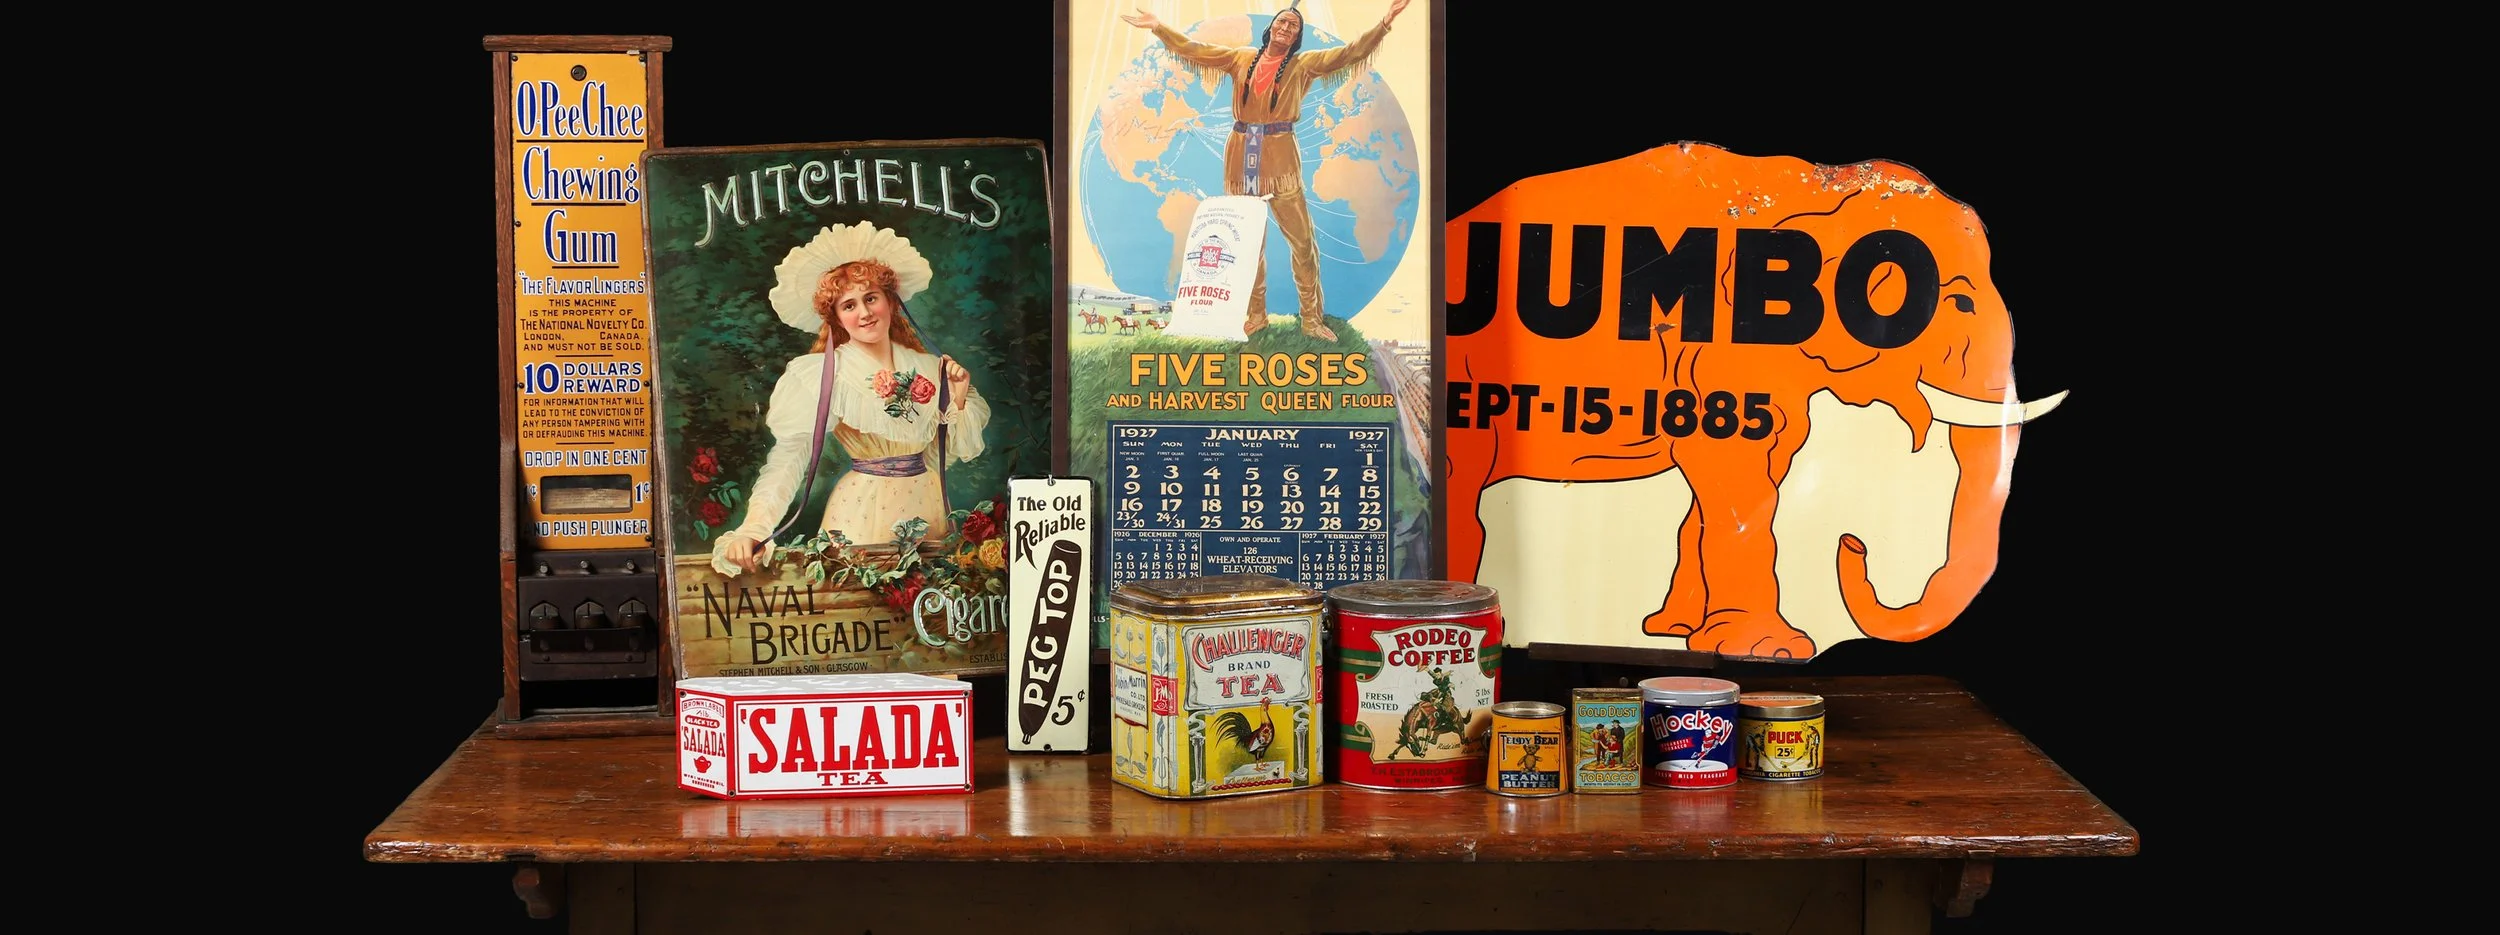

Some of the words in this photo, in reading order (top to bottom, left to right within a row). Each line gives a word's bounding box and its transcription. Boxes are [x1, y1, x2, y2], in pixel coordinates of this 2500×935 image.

[522, 146, 639, 203] Chewing
[694, 159, 1001, 248] MITCHELL'S
[544, 208, 619, 264] Gum
[545, 276, 593, 295] FLAVOR
[1446, 221, 1940, 349] JUMBO
[1178, 286, 1199, 299] FIVE
[1200, 286, 1231, 302] ROSES
[549, 299, 571, 307] THIS
[574, 299, 617, 307] MACHINE
[562, 309, 614, 317] PROPERTY
[520, 318, 537, 330] THE
[539, 319, 585, 331] NATIONAL
[586, 319, 629, 331] NOVELTY
[523, 343, 543, 351] AND
[547, 343, 574, 351] MUST
[563, 361, 643, 377] DOLLARS
[1130, 353, 1227, 387] FIVE
[1239, 353, 1368, 387] ROSES
[523, 362, 561, 395] 10
[563, 377, 641, 394] REWARD
[523, 398, 540, 406] FOR
[543, 398, 599, 406] INFORMATION
[625, 397, 644, 405] WILL
[1106, 394, 1142, 408] AND
[1148, 391, 1249, 411] HARVEST
[1260, 391, 1333, 415] QUEEN
[1341, 394, 1396, 408] FLOUR
[524, 409, 547, 417] LEAD
[549, 409, 560, 417] TO
[580, 408, 631, 416] CONVICTION
[634, 408, 645, 416] OF
[522, 419, 539, 427] ANY
[541, 419, 572, 427] PERSON
[574, 419, 620, 427] TAMPERING
[623, 418, 645, 426] WITH
[523, 430, 534, 438] OR
[536, 429, 585, 438] DEFRAUDING
[587, 429, 606, 437] THIS
[1120, 428, 1158, 438] 1927
[1205, 428, 1300, 441] JANUARY
[1349, 431, 1384, 440] 1927
[524, 451, 563, 467] DROP
[566, 451, 579, 466] IN
[583, 450, 609, 466] ONE
[613, 450, 648, 465] CENT
[1366, 452, 1373, 465] 1
[1125, 465, 1141, 479] 2
[1163, 465, 1179, 479] 3
[1203, 466, 1221, 480] 4
[1245, 467, 1260, 481] 5
[1283, 467, 1300, 481] 6
[1323, 468, 1339, 482] 7
[1361, 468, 1378, 483] 8
[1123, 481, 1141, 495] 9
[1160, 482, 1183, 496] 10
[1204, 483, 1220, 497] 11
[1242, 484, 1263, 497] 12
[1282, 484, 1302, 498] 13
[1319, 484, 1341, 499] 14
[1359, 485, 1381, 499] 15
[1016, 496, 1047, 512] The
[1052, 495, 1082, 511] Old
[1121, 498, 1143, 512] 16
[1161, 499, 1183, 512] 17
[1202, 499, 1222, 513] 18
[1242, 500, 1264, 513] 19
[1279, 501, 1305, 514] 20
[1320, 502, 1340, 515] 21
[1358, 502, 1382, 515] 22
[553, 521, 587, 536] PUSH
[591, 519, 649, 535] PLUNGER
[1200, 515, 1222, 529] 25
[1240, 516, 1264, 529] 26
[1280, 517, 1303, 530] 27
[1318, 517, 1342, 530] 28
[1357, 517, 1382, 531] 29
[1014, 513, 1086, 570] Reliable
[1207, 555, 1293, 565] WHEAT-RECEIVING
[1222, 565, 1278, 574] ELEVATORS
[1038, 559, 1073, 625] TOP
[1394, 628, 1472, 650] RODEO
[1191, 628, 1307, 673] CHALLENGER
[1388, 647, 1476, 667] COFFEE
[719, 668, 754, 677] STEPHEN
[757, 666, 793, 675] MITCHELL
[795, 666, 802, 674] &
[803, 665, 820, 673] SON
[826, 662, 868, 673] GLASGOW
[1023, 635, 1059, 708] PEG
[1228, 660, 1271, 672] BRAND
[1216, 672, 1285, 698] TEA
[1475, 689, 1481, 697] 5
[1365, 692, 1394, 701] FRESH
[1477, 697, 1489, 706] NET
[1361, 701, 1399, 711] ROASTED
[1579, 705, 1607, 718] GOLD
[1608, 705, 1637, 717] DUST
[1650, 710, 1733, 745] Hockey
[1767, 731, 1804, 744] PUCK
[1500, 734, 1531, 760] TEDDY
[1534, 735, 1559, 745] BEAR
[816, 771, 889, 787] TEA
[1501, 773, 1557, 781] PEANUT
[1580, 773, 1636, 783] TOBACCO
